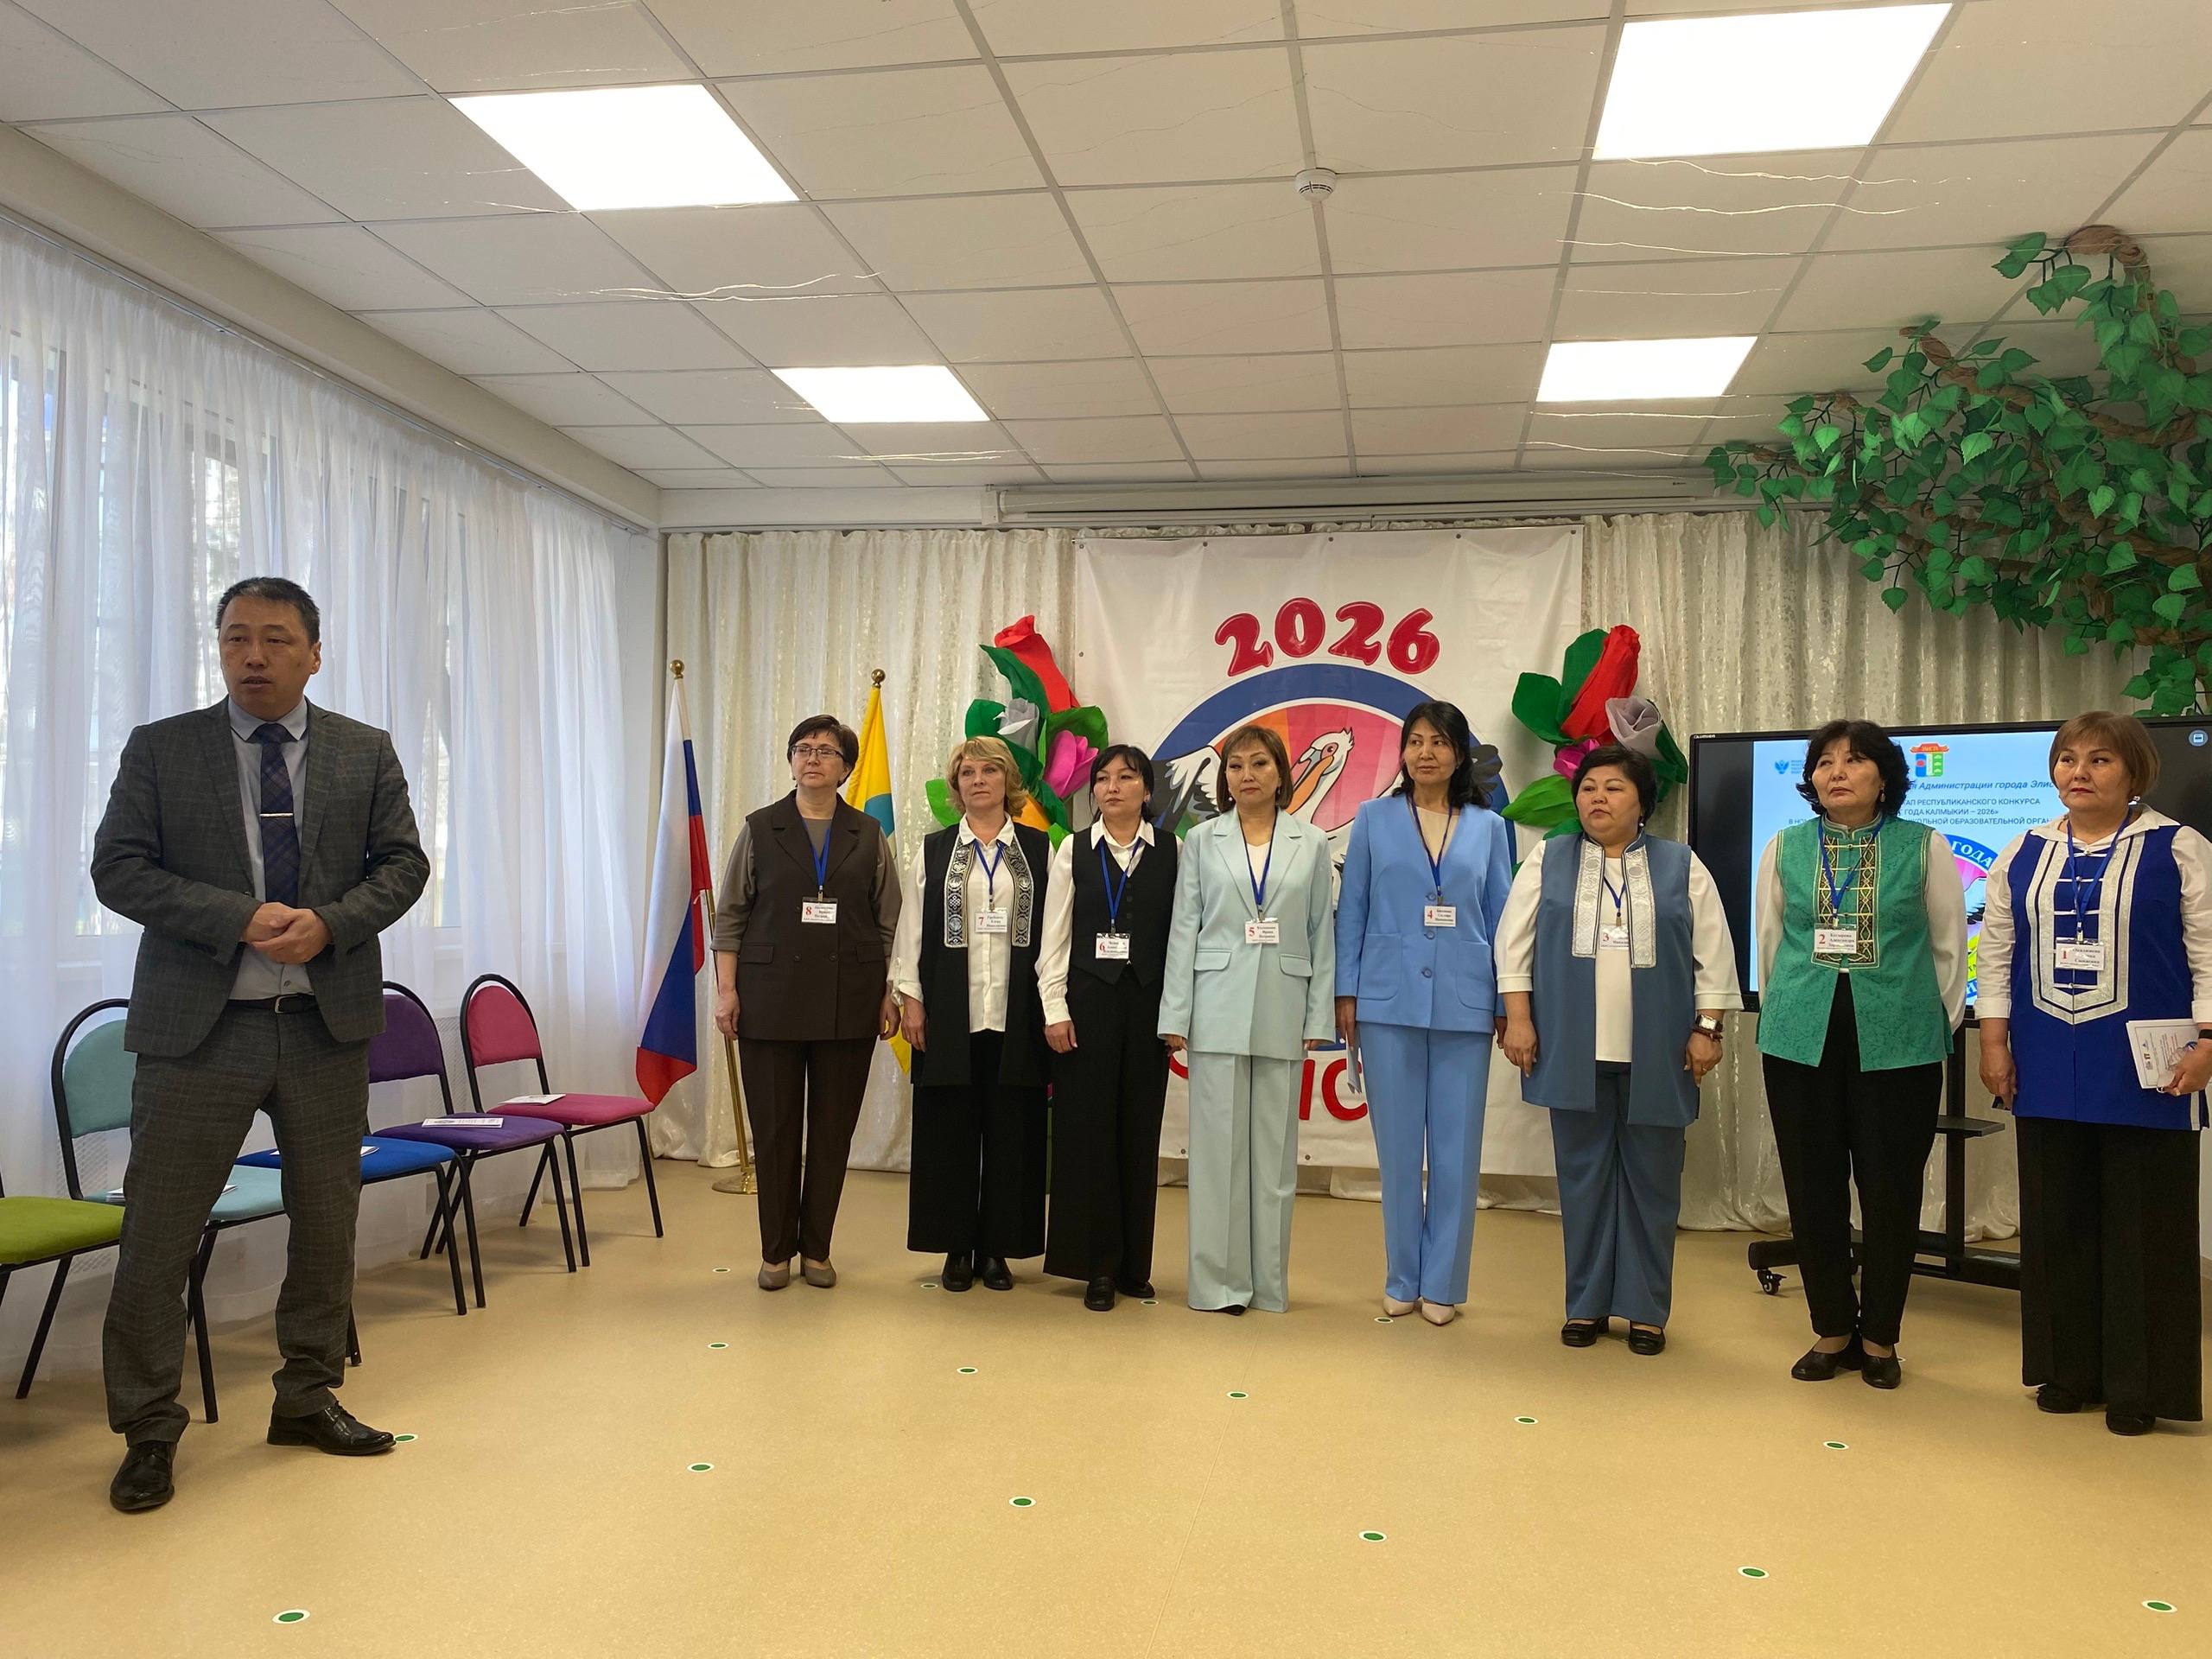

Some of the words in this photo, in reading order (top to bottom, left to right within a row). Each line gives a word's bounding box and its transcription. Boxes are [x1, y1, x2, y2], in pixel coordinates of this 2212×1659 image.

[1214, 597, 1440, 677] 2026
[1919, 782, 1993, 791] Администрации
[1952, 841, 1993, 868] ГОДА
[805, 906, 812, 916] 8
[1427, 910, 1433, 918] 4
[978, 917, 984, 925] 7
[1249, 927, 1255, 937] 5
[1819, 934, 1826, 944] 2
[1099, 943, 1105, 951] 6
[2063, 950, 2068, 959] 1
